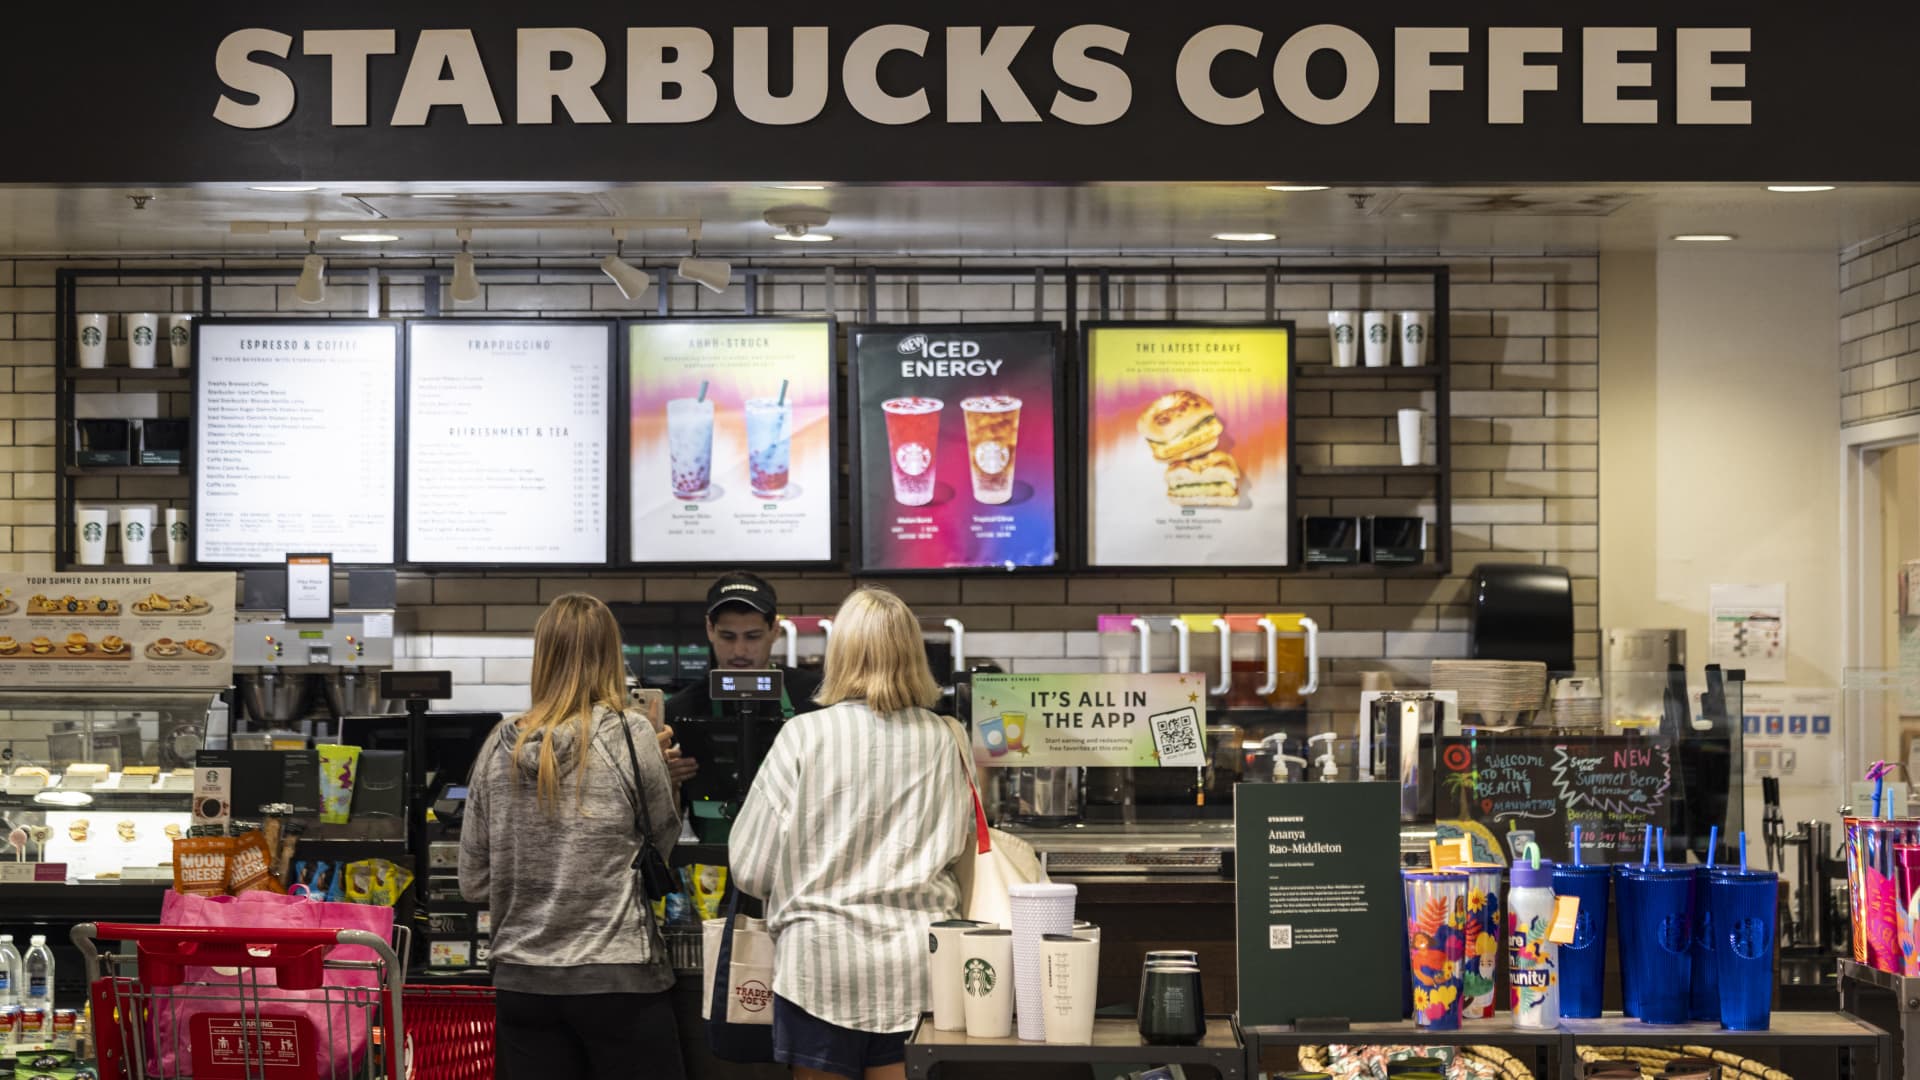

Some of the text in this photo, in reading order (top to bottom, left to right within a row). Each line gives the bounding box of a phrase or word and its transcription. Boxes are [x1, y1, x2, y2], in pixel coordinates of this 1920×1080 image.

[213, 24, 1753, 128] STARBUCKS COFFEE
[240, 340, 298, 350] ESPRESSO
[303, 340, 311, 350] &
[468, 340, 552, 351] FRAPPUCCINO
[900, 336, 925, 352] NEW
[922, 341, 980, 358] ICED
[1136, 343, 1241, 353] THE LATEST CRAVE
[901, 360, 1003, 378] ENERGY
[536, 427, 544, 438] &
[549, 427, 570, 438] TEA
[27, 577, 151, 585] YOUR SUMMER DAY STARTS HERE
[1032, 691, 1147, 708] IT'S ALL IN
[1042, 713, 1136, 729] THE APP
[1485, 754, 1545, 769] WELCOME
[1613, 748, 1652, 769] NEW
[1481, 768, 1497, 780] TO
[1576, 770, 1663, 788] Summer Berry
[1567, 808, 1603, 821] Barista
[1268, 829, 1306, 841] Ananya
[1269, 843, 1342, 855] Rao-Middleton
[180, 853, 226, 869] MOON
[233, 846, 263, 868] OON
[181, 868, 225, 881] CHEESE
[735, 986, 774, 999] TRADER
[739, 996, 768, 1006] JOE'S
